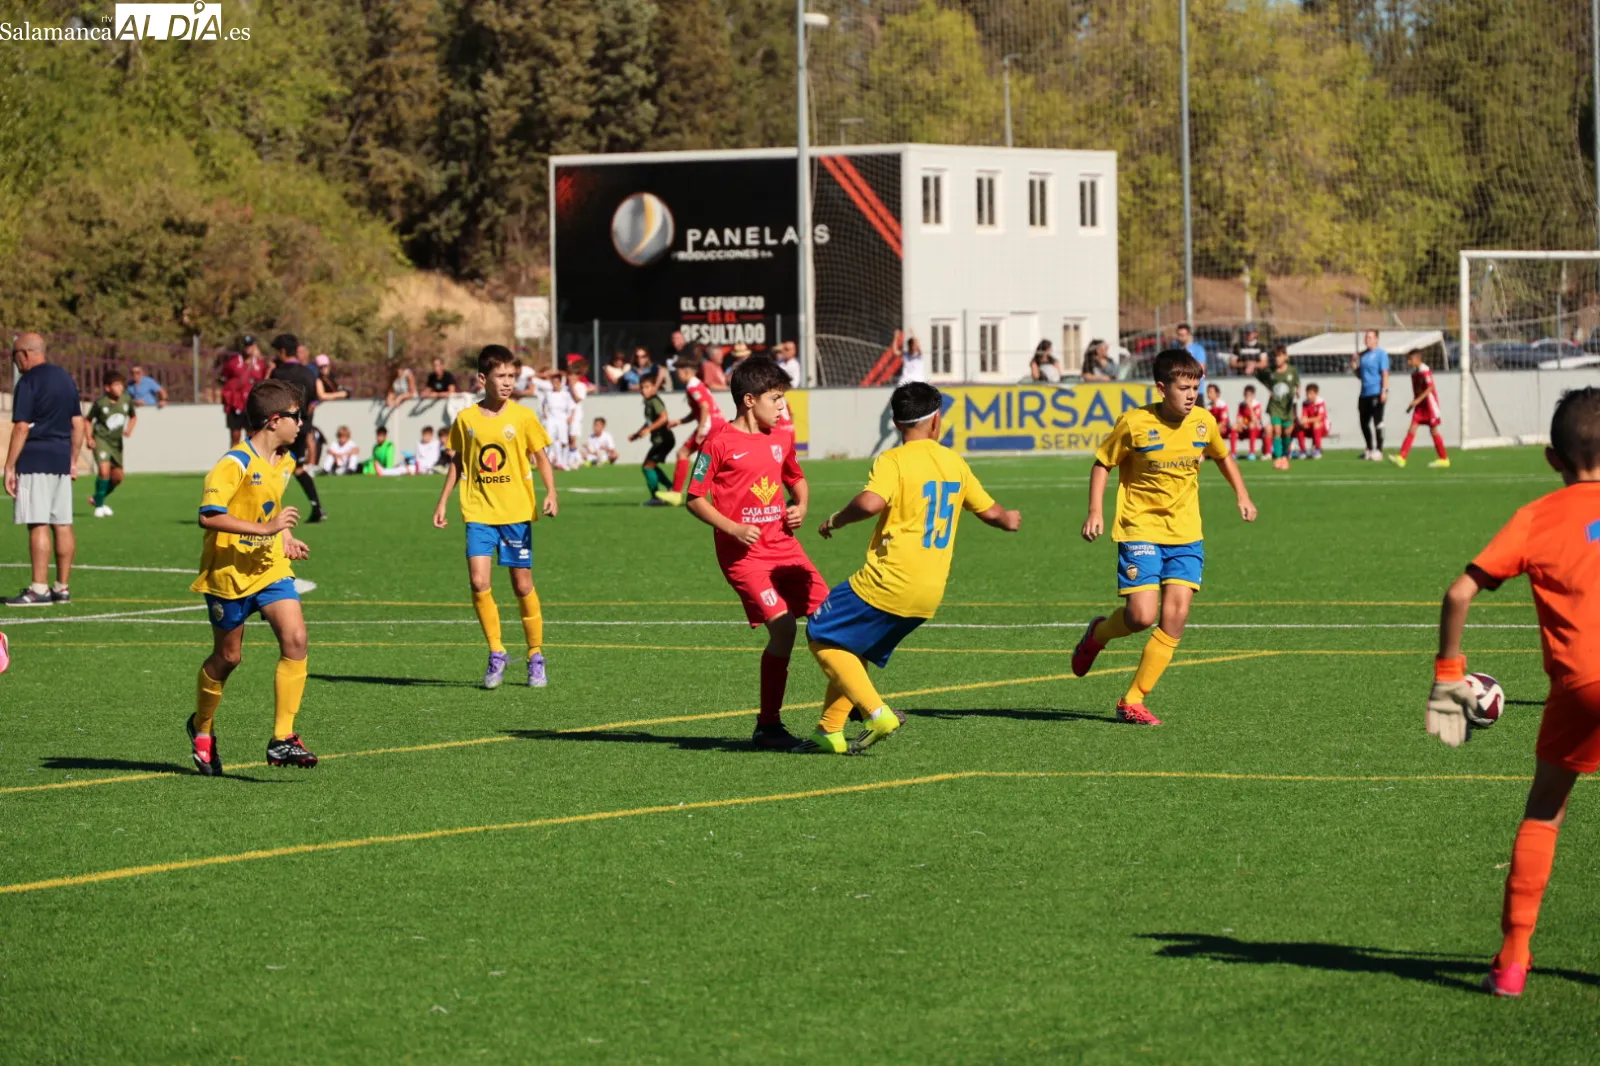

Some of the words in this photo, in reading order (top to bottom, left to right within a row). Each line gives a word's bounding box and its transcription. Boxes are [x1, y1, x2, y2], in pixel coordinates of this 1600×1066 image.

[680, 296, 696, 312] EL
[699, 295, 765, 311] ESFUERZO
[680, 323, 766, 345] RESULTADO
[964, 386, 1153, 430] MIRSAN
[922, 479, 961, 549] 15
